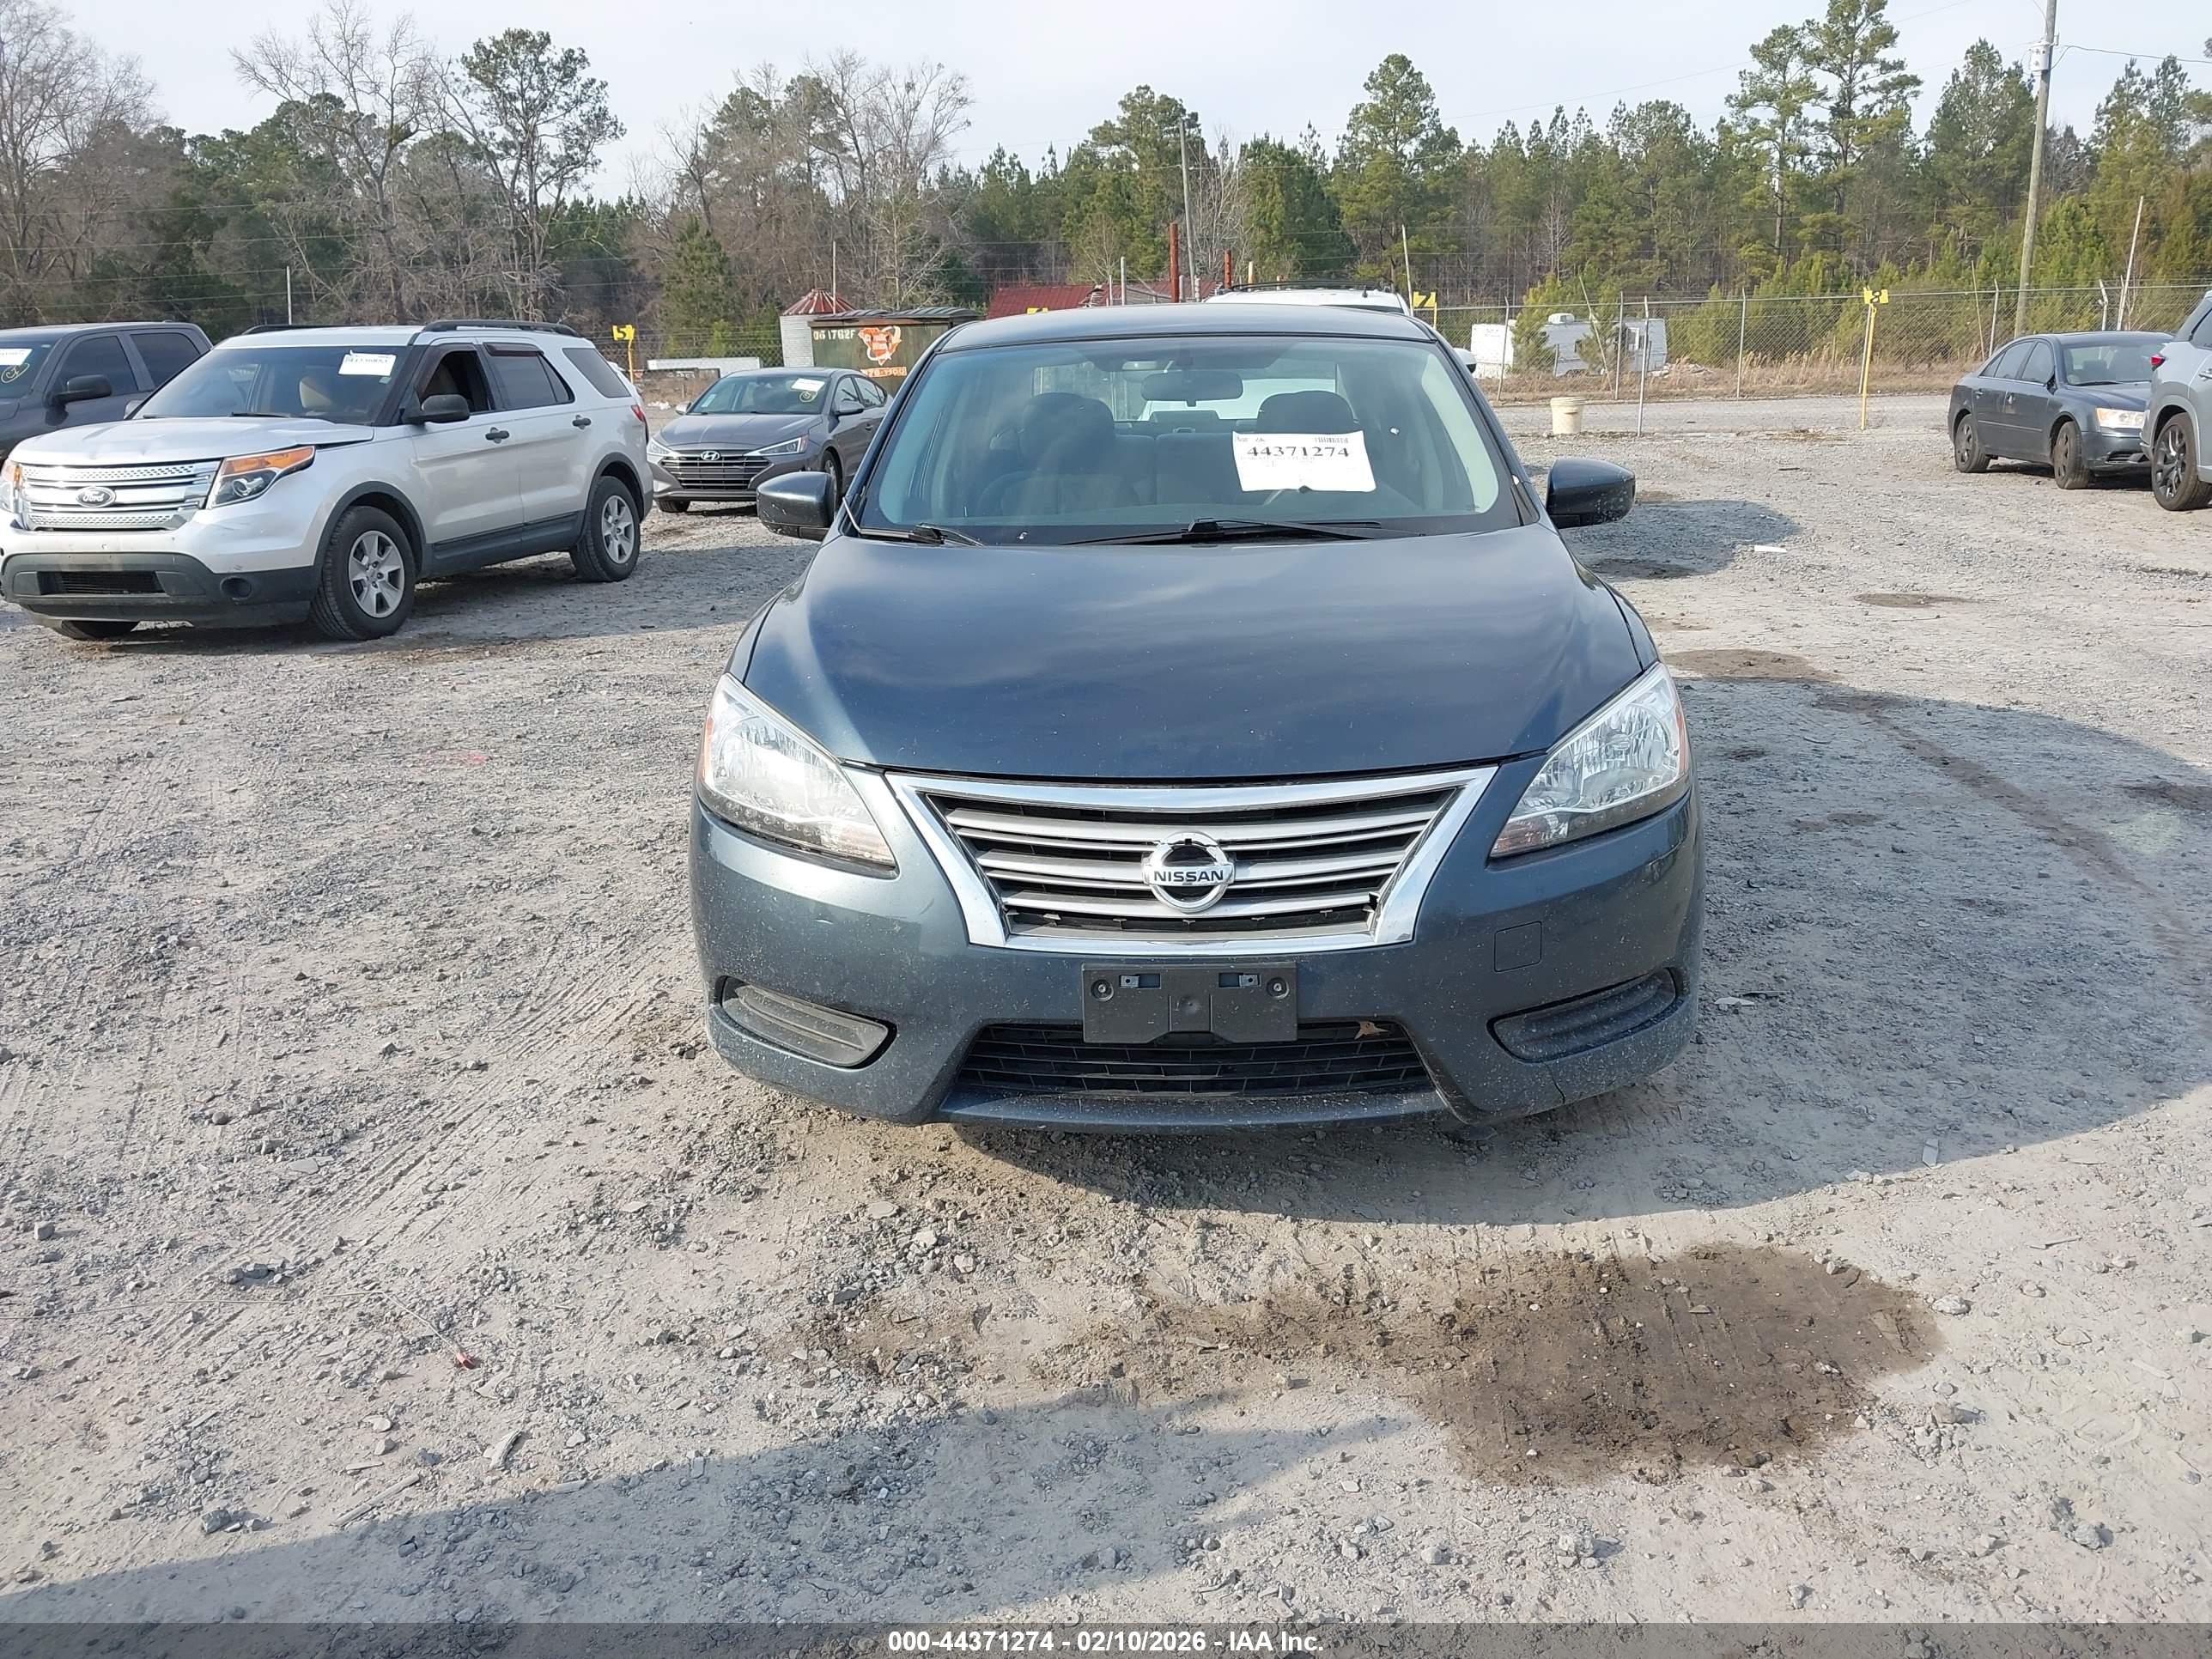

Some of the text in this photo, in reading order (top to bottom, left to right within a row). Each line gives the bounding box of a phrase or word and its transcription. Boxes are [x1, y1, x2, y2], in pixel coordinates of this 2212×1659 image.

[1247, 446, 1349, 457] 44371274
[82, 490, 106, 503] Ford
[1153, 870, 1224, 882] NISSAN
